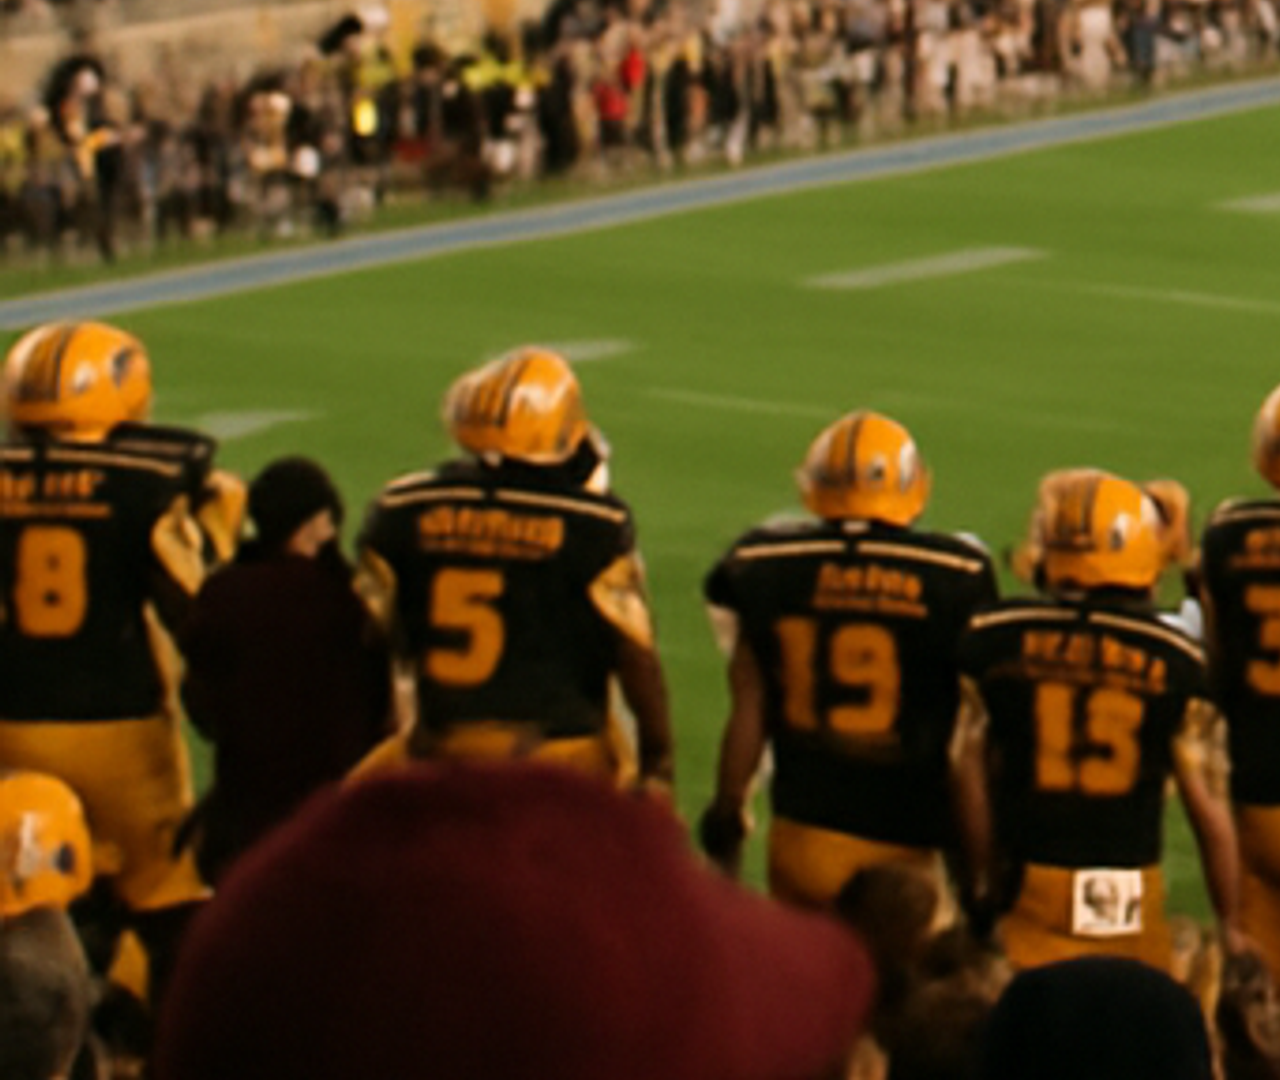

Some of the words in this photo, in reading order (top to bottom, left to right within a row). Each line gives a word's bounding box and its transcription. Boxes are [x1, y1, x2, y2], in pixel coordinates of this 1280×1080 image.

[16, 525, 87, 637] 8
[427, 567, 504, 687] 5
[776, 617, 898, 733] 19
